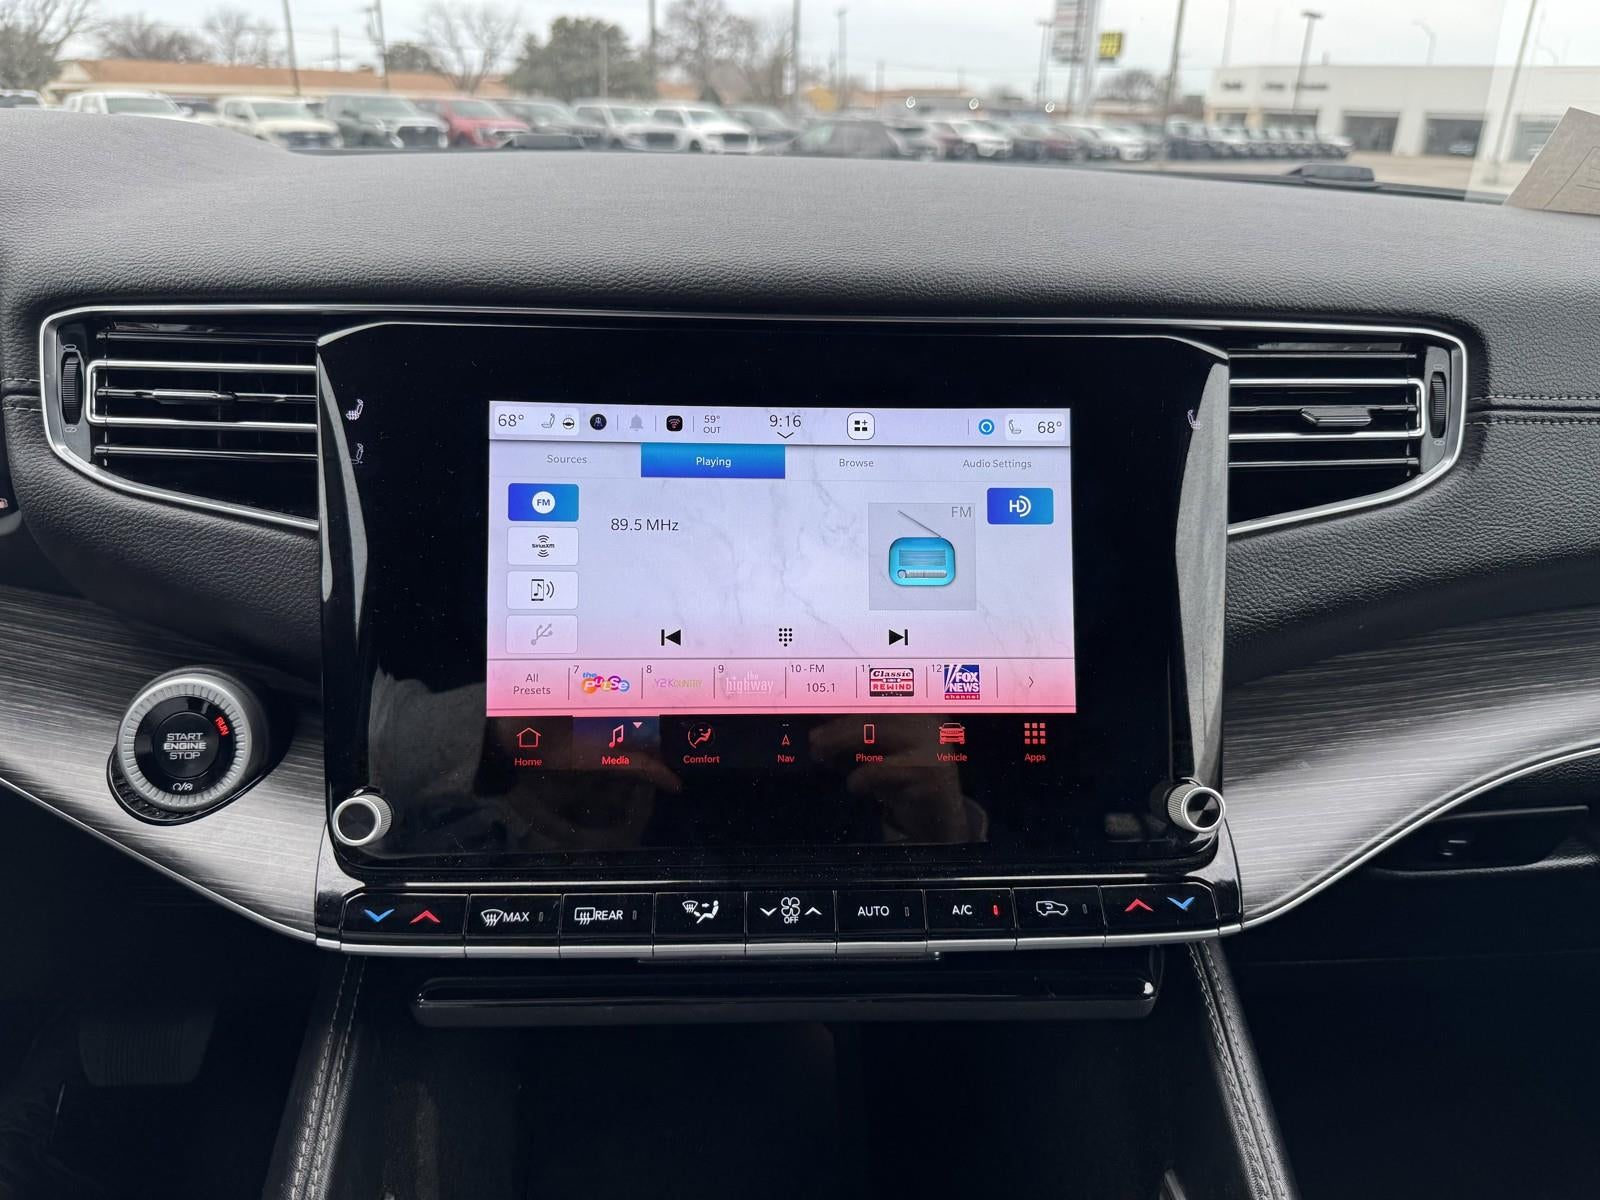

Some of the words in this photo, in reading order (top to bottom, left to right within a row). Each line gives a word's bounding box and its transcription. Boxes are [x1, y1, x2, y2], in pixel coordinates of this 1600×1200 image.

[769, 414, 802, 428] 9:16
[703, 426, 721, 434] OUT
[546, 453, 588, 465] Sources
[695, 455, 732, 468] Playing
[838, 458, 874, 468] Browse
[962, 458, 991, 469] Audio
[992, 458, 1032, 470] Settings
[536, 498, 551, 507] FM
[951, 506, 972, 518] FM
[610, 518, 642, 531] 89.5
[646, 518, 679, 531] MHz
[573, 665, 580, 674] 7
[646, 665, 652, 674] 8
[718, 664, 725, 674] 9
[791, 664, 802, 673] 10
[810, 664, 825, 673] FM
[931, 664, 943, 673] 12
[525, 673, 539, 683] All
[872, 670, 911, 678] Classic
[955, 672, 979, 683] FOX
[513, 685, 551, 696] Presets
[807, 683, 836, 693] 105.1
[872, 683, 912, 691] REWIND
[949, 682, 980, 693] NEWS
[215, 717, 229, 736] RUN
[166, 732, 203, 741] START
[163, 742, 207, 750] ENGINE
[169, 751, 201, 760] STOP
[601, 755, 630, 765] Media
[683, 754, 720, 764] Comfort
[777, 754, 795, 763] Nav
[855, 753, 884, 763] Phone
[936, 753, 968, 763] Vehicle
[1024, 753, 1047, 764] Apps
[514, 757, 542, 767] Home
[857, 906, 890, 917] AUTO
[952, 904, 973, 916] A/C
[502, 911, 530, 923] MAX
[594, 910, 624, 921] REAR
[783, 915, 799, 924] OFF
